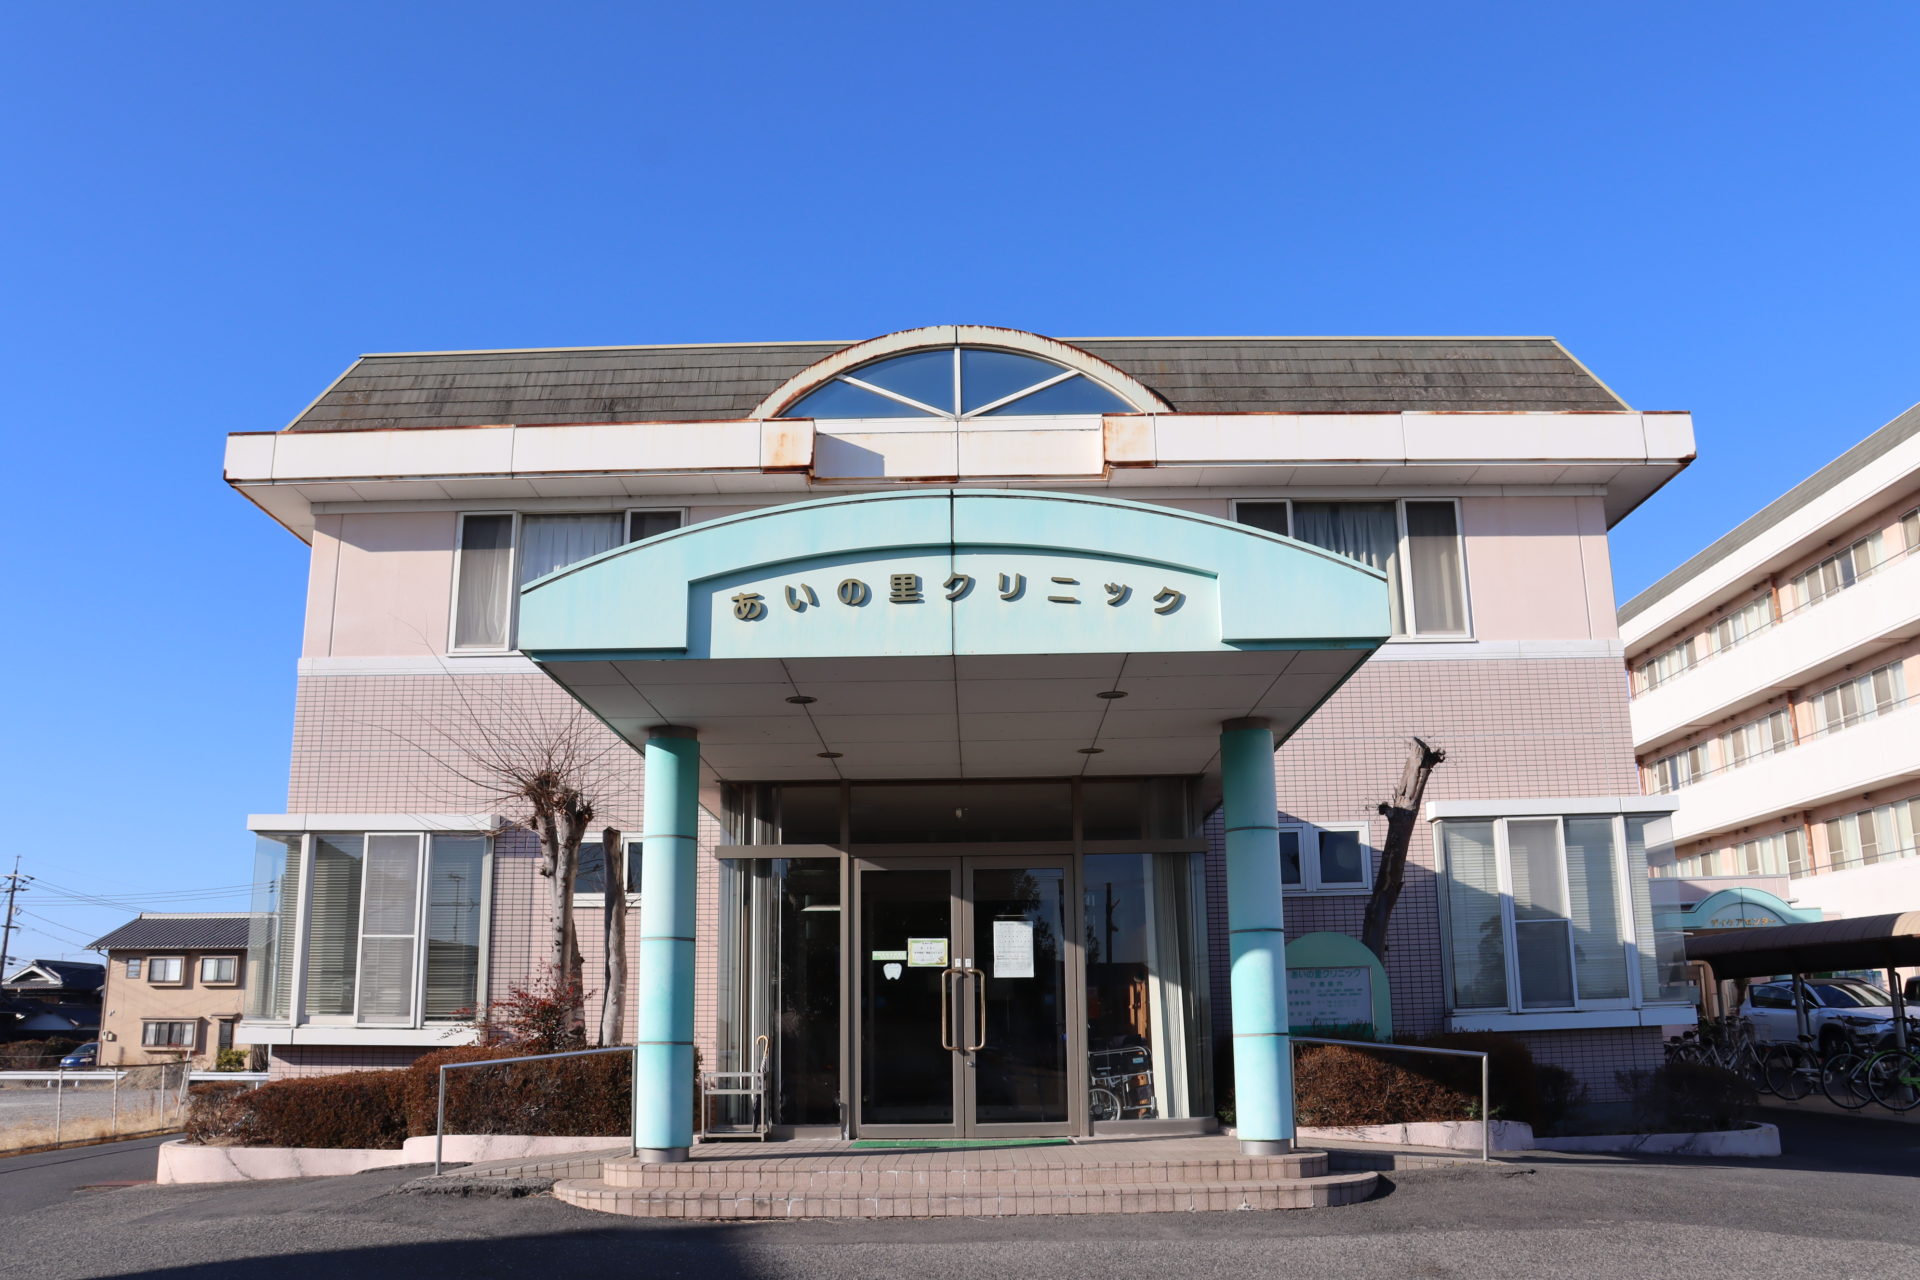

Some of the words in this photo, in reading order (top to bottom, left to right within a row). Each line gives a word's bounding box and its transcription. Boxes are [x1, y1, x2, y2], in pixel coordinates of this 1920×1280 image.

[732, 573, 1182, 620] あいの里クリニック
